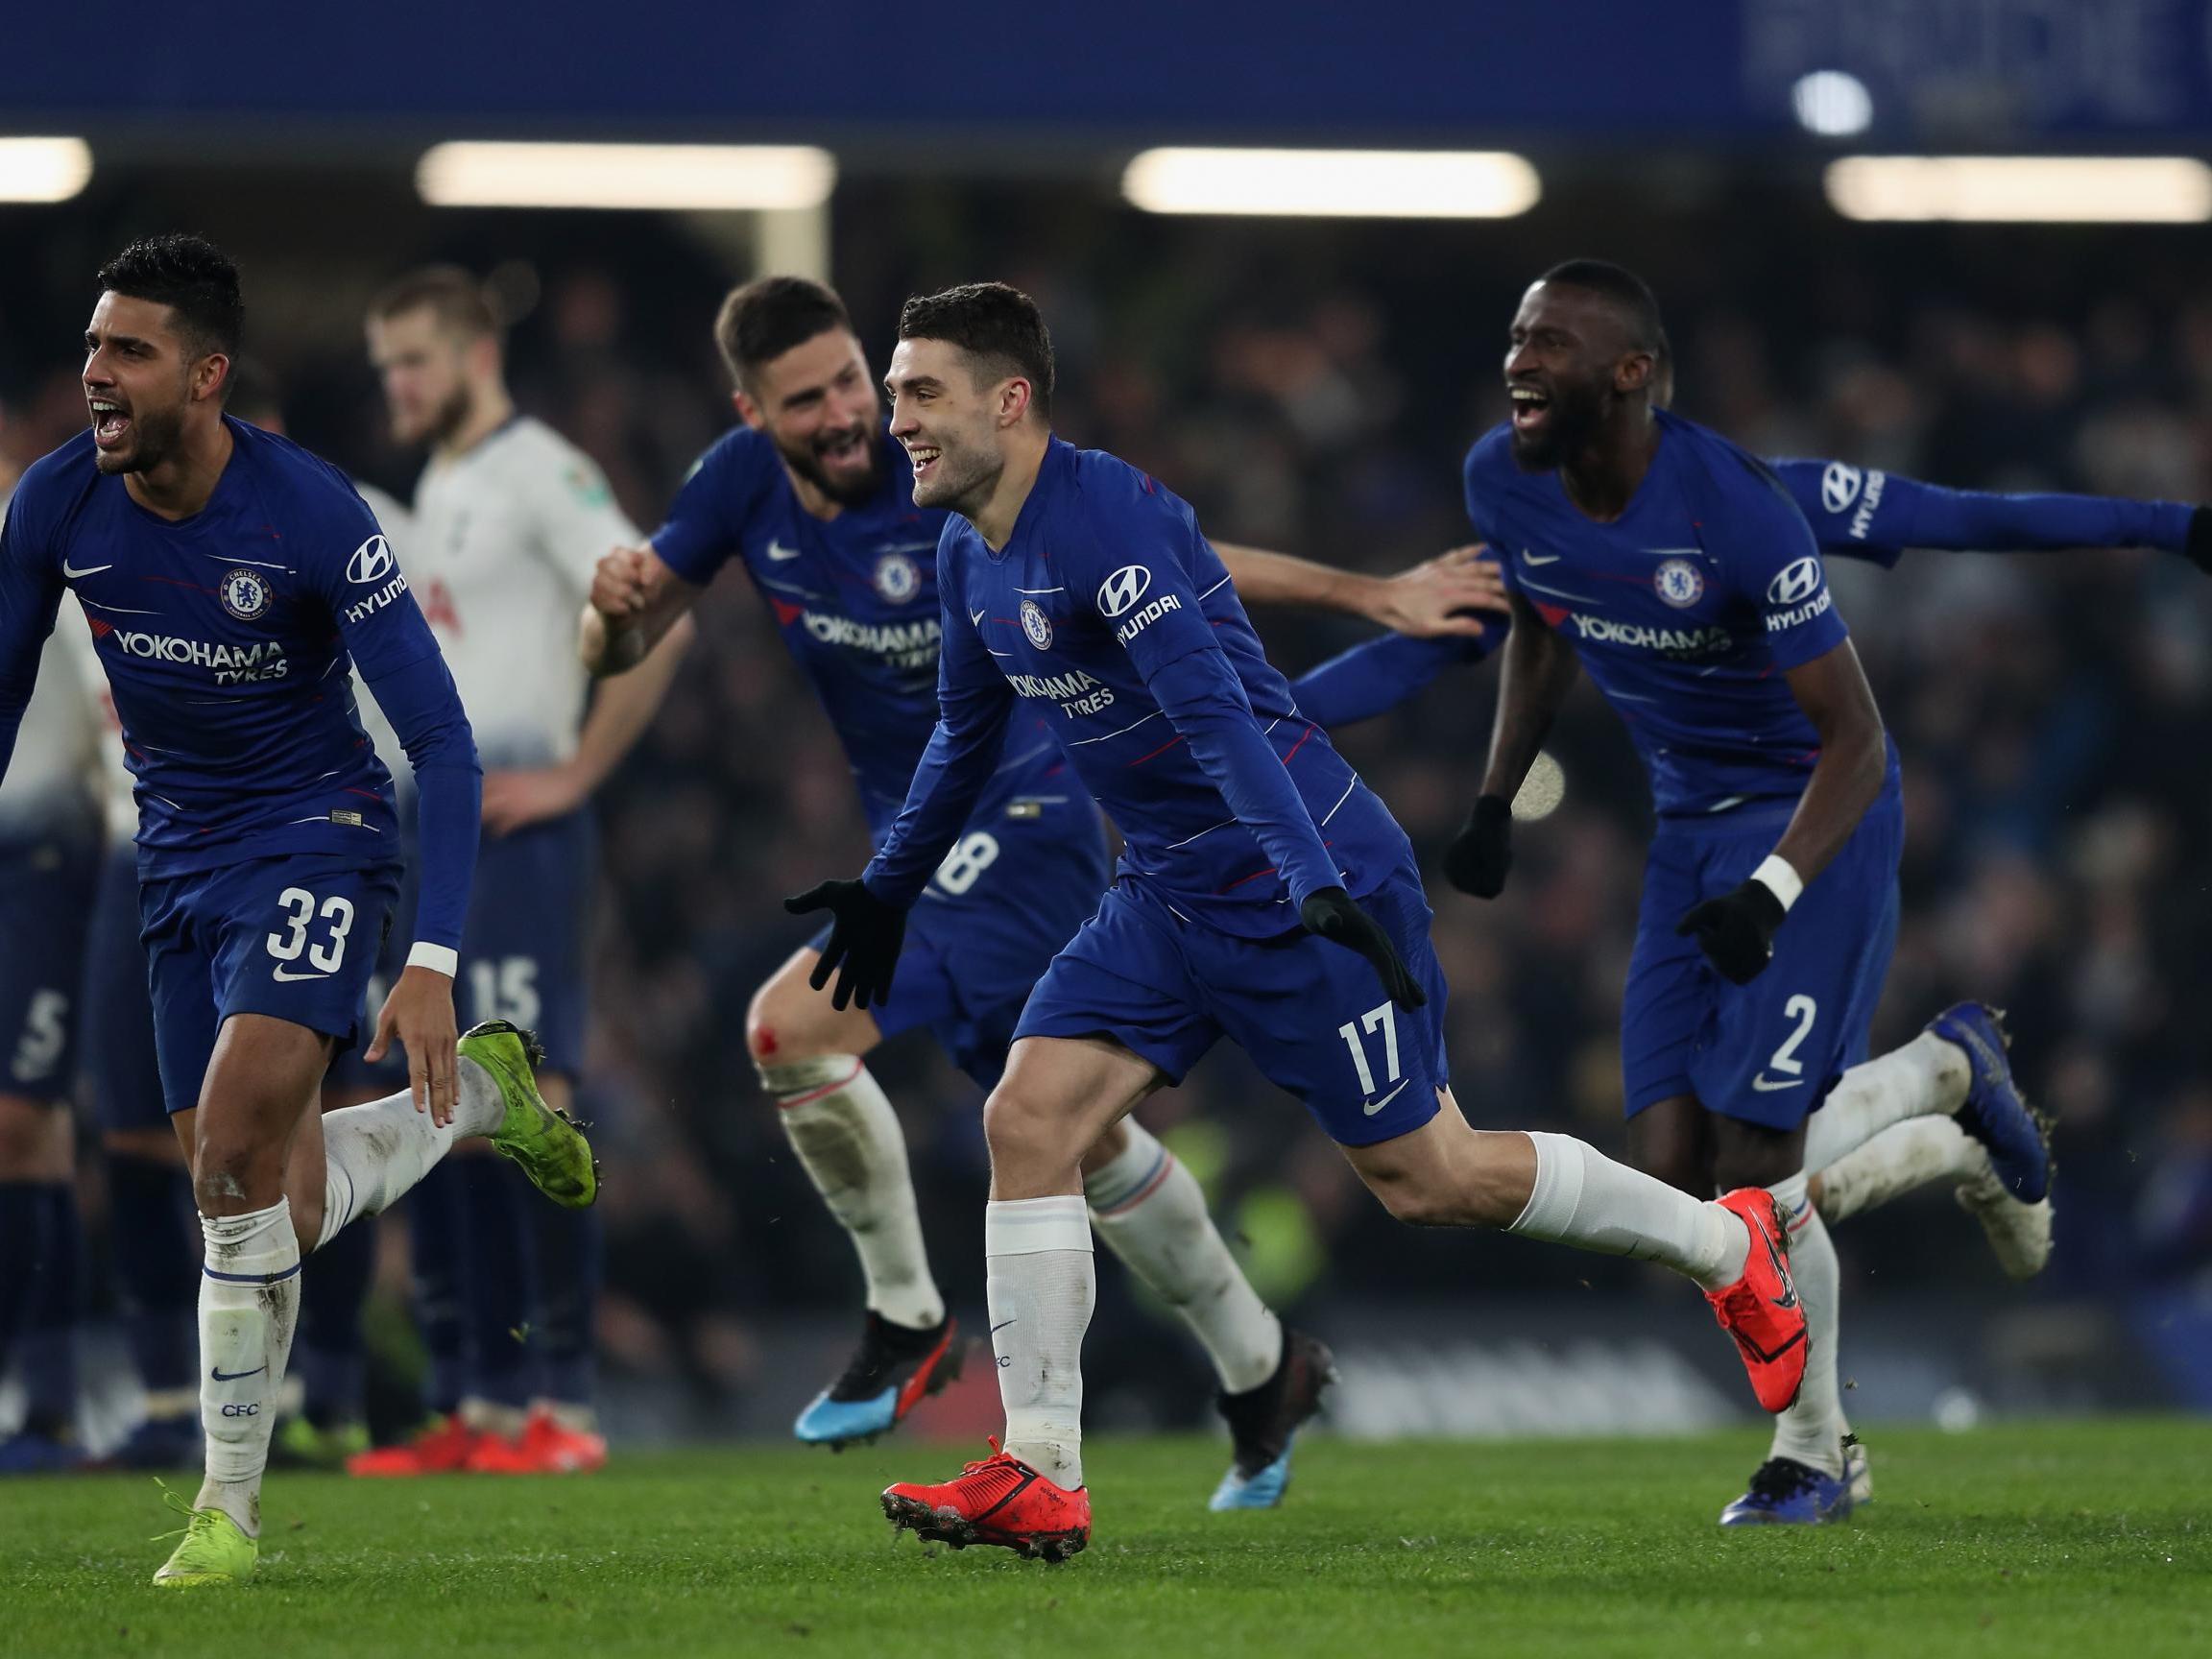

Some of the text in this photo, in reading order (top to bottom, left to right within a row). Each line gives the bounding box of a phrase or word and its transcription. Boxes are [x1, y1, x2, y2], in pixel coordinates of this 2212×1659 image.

[228, 570, 262, 584] CHELSEA
[1117, 594, 1183, 649] YUNDAI
[113, 628, 286, 669] YOKOHAMA
[214, 659, 289, 685] TYRES
[1061, 687, 1115, 719] TYRES
[266, 886, 355, 974] 33
[469, 956, 541, 1030] 15
[1338, 999, 1401, 1095] 17
[1769, 993, 1816, 1075] 2
[222, 1403, 259, 1417] CFC
